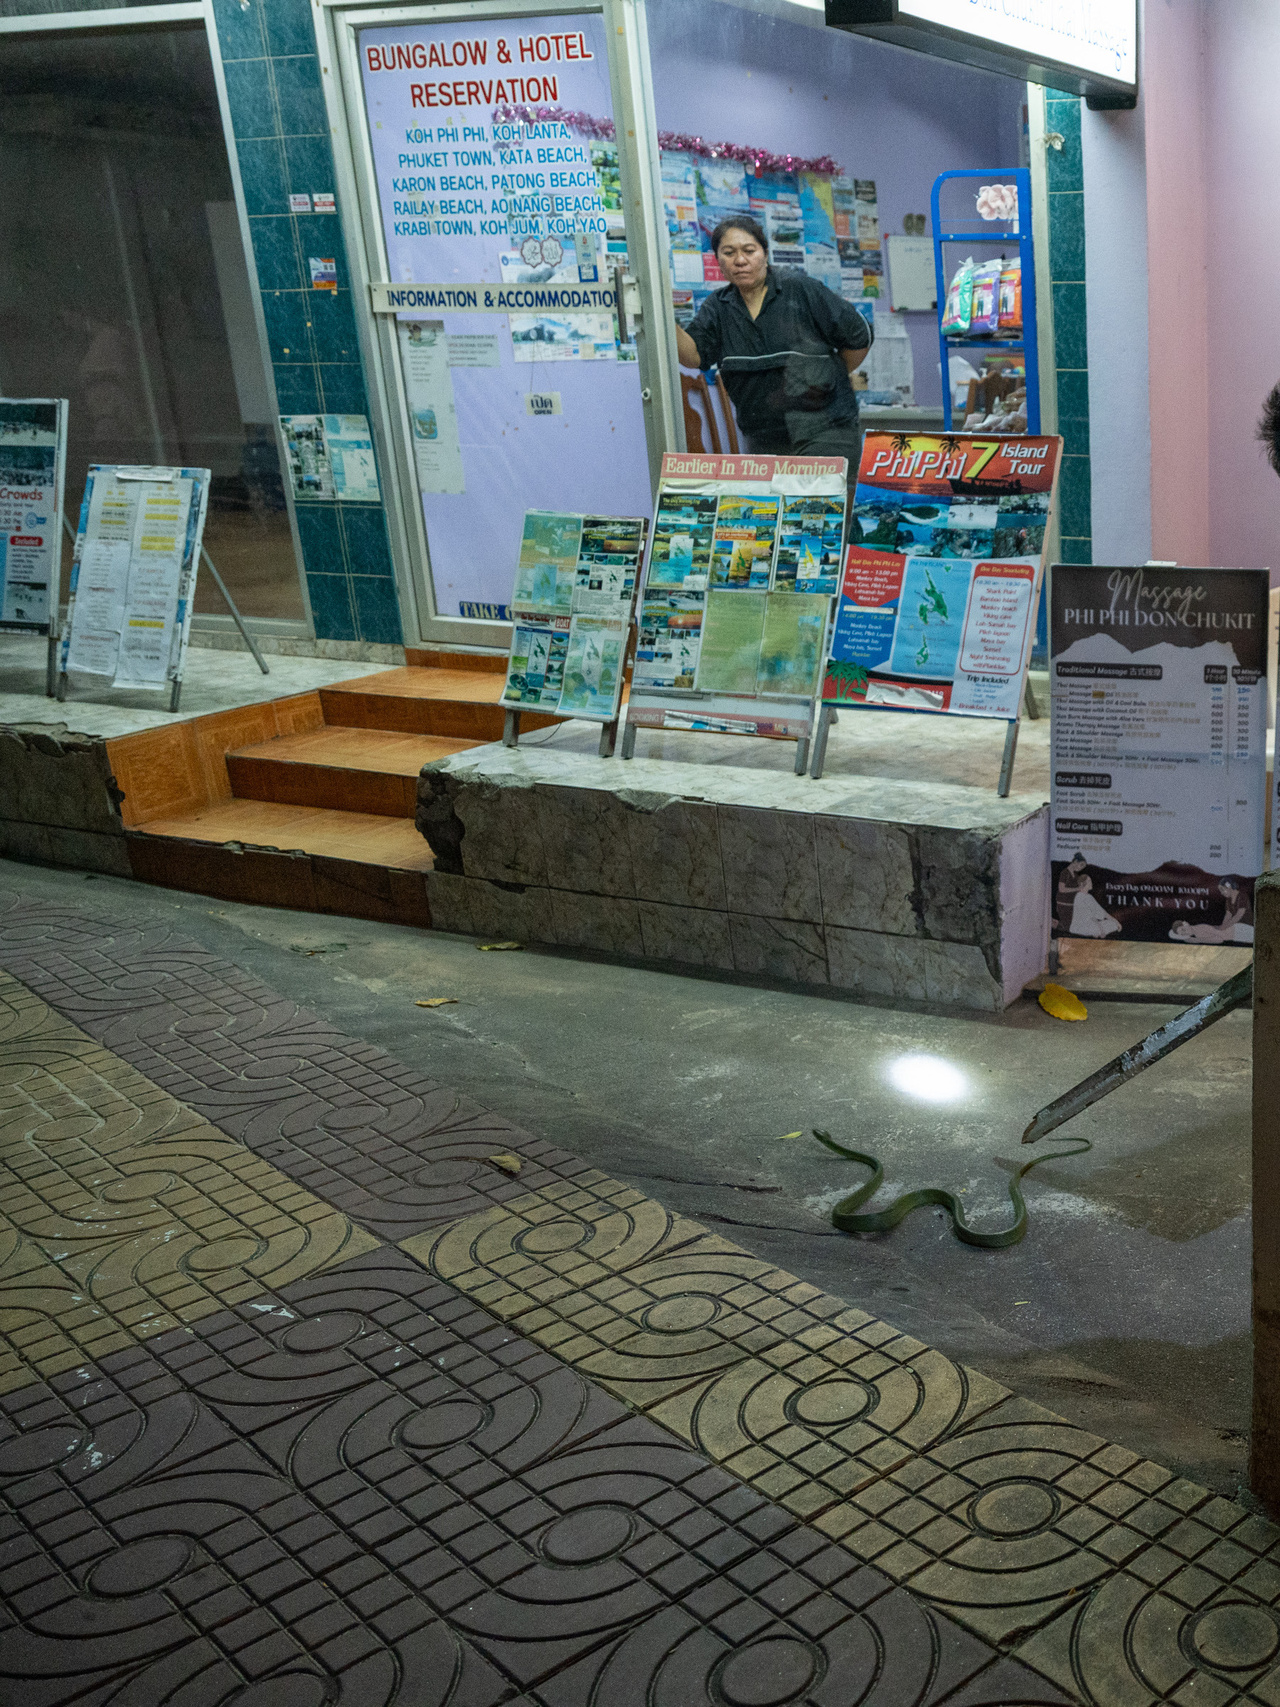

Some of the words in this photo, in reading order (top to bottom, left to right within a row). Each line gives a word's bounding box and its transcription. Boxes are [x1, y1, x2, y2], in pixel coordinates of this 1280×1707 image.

[367, 40, 487, 71] BUNGALOW
[497, 39, 511, 64] &
[519, 33, 592, 62] HOTEL
[410, 76, 558, 108] RESERVATION
[405, 127, 433, 144] KOH
[437, 127, 459, 143] PHI
[464, 126, 488, 143] PHI,
[492, 125, 521, 141] KOH
[526, 123, 571, 140] LANTA,
[399, 152, 449, 168] PHUKET
[453, 150, 496, 167] TOWN,
[499, 149, 534, 164] KATA
[538, 147, 588, 164] BEACH,
[392, 176, 436, 192] KARON
[440, 175, 488, 191] BEACH,
[492, 173, 545, 189] PATONG
[550, 172, 600, 189] BEACH,
[394, 200, 436, 215] RAILAY
[440, 199, 488, 215] BEACH,
[491, 199, 509, 213] AO
[513, 198, 550, 213] NANG
[555, 196, 605, 212] BEACH,
[394, 221, 432, 235] KRABI
[436, 220, 477, 236] TOWN,
[480, 220, 509, 234] KOH
[512, 219, 544, 235] JUM,
[547, 218, 575, 233] KOH
[579, 218, 607, 233] YAO
[387, 290, 477, 307] INFORMATION
[484, 291, 495, 307] &
[665, 457, 717, 475] Earlier
[720, 459, 735, 475] In
[740, 459, 768, 476] The
[773, 461, 837, 476] Morning
[964, 441, 1000, 478] 7
[1001, 443, 1049, 459] Island
[1008, 459, 1045, 475] Tour
[0, 487, 43, 500] Crowds
[1107, 568, 1206, 621] Massage
[460, 602, 500, 619] TAKE
[1064, 608, 1094, 624] PHI
[1100, 609, 1129, 625] PHI
[1135, 609, 1177, 627] DON
[1183, 611, 1255, 629] CHUKIT
[556, 616, 570, 629] BOAT
[966, 674, 979, 684] Trip
[1058, 666, 1096, 675] Traditional
[1097, 667, 1128, 676] Massage
[1106, 895, 1163, 908] THANK
[1174, 898, 1209, 910] YOU
